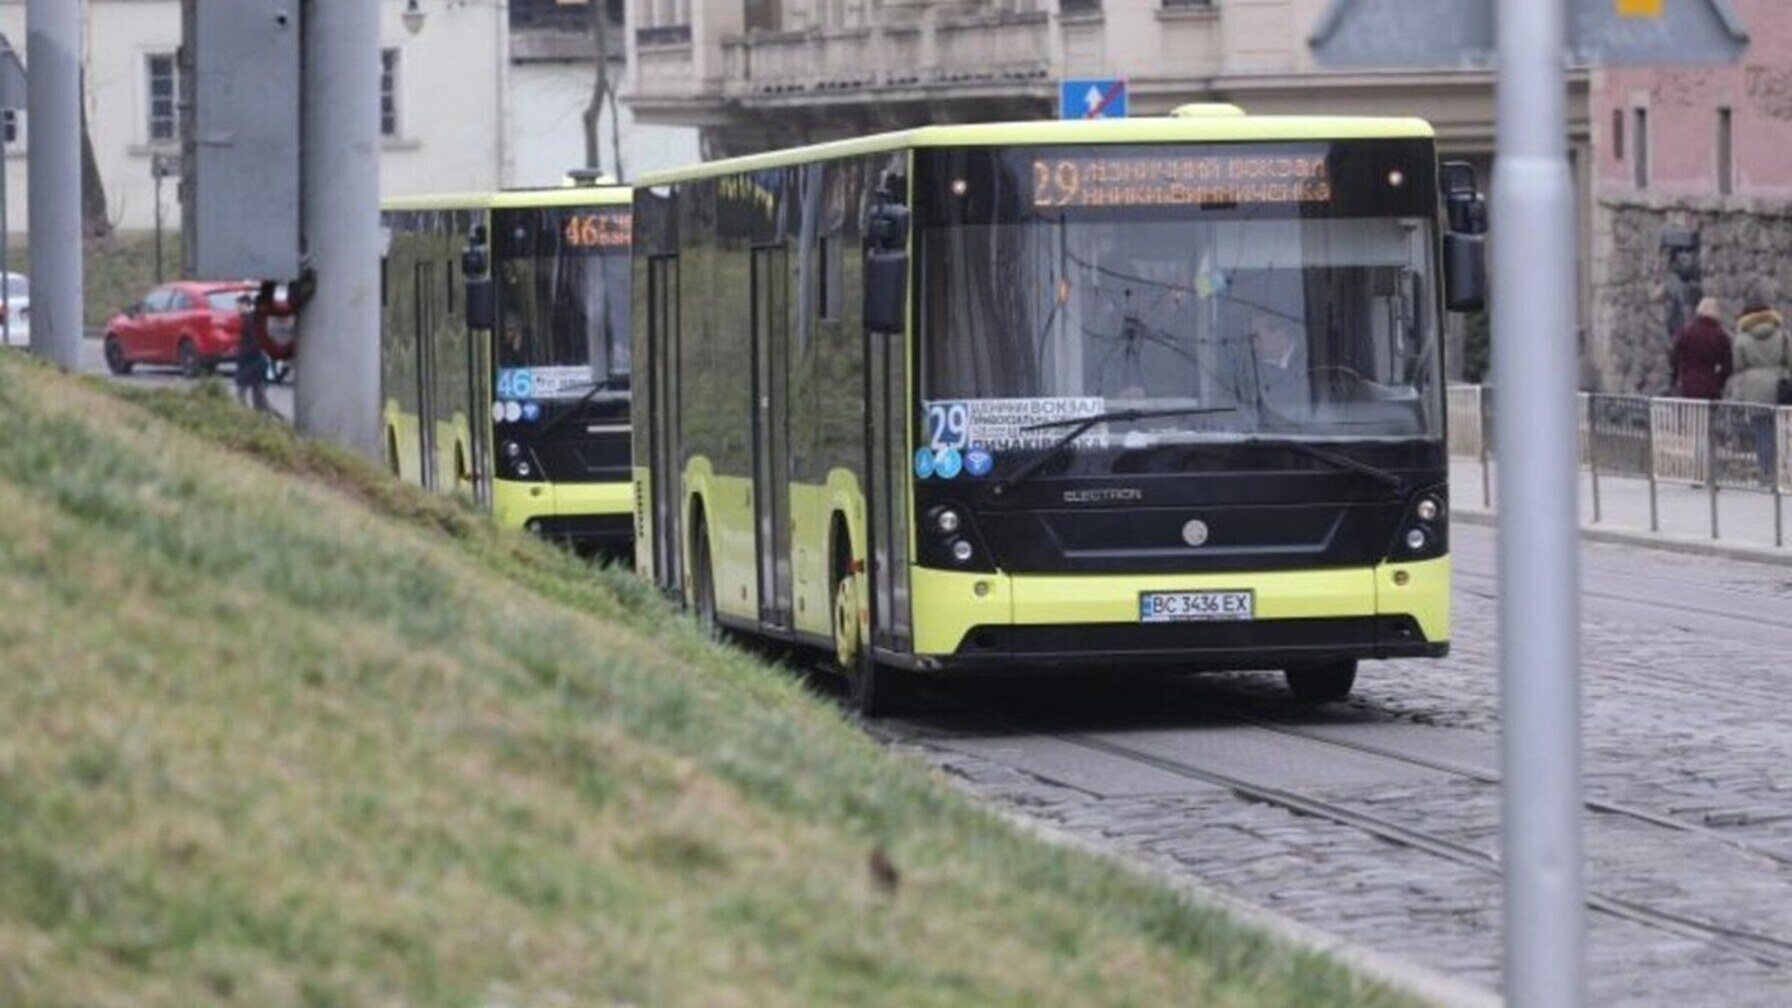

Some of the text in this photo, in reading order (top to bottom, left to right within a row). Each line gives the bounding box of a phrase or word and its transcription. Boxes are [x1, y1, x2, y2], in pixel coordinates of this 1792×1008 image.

[1034, 161, 1079, 206] 29
[565, 215, 597, 246] 46
[498, 369, 531, 397] 46
[931, 403, 967, 450] 29
[1063, 489, 1142, 502] ELECTRON
[1153, 596, 1177, 613] BC
[1182, 595, 1219, 613] 3436
[1223, 594, 1247, 611] EX
